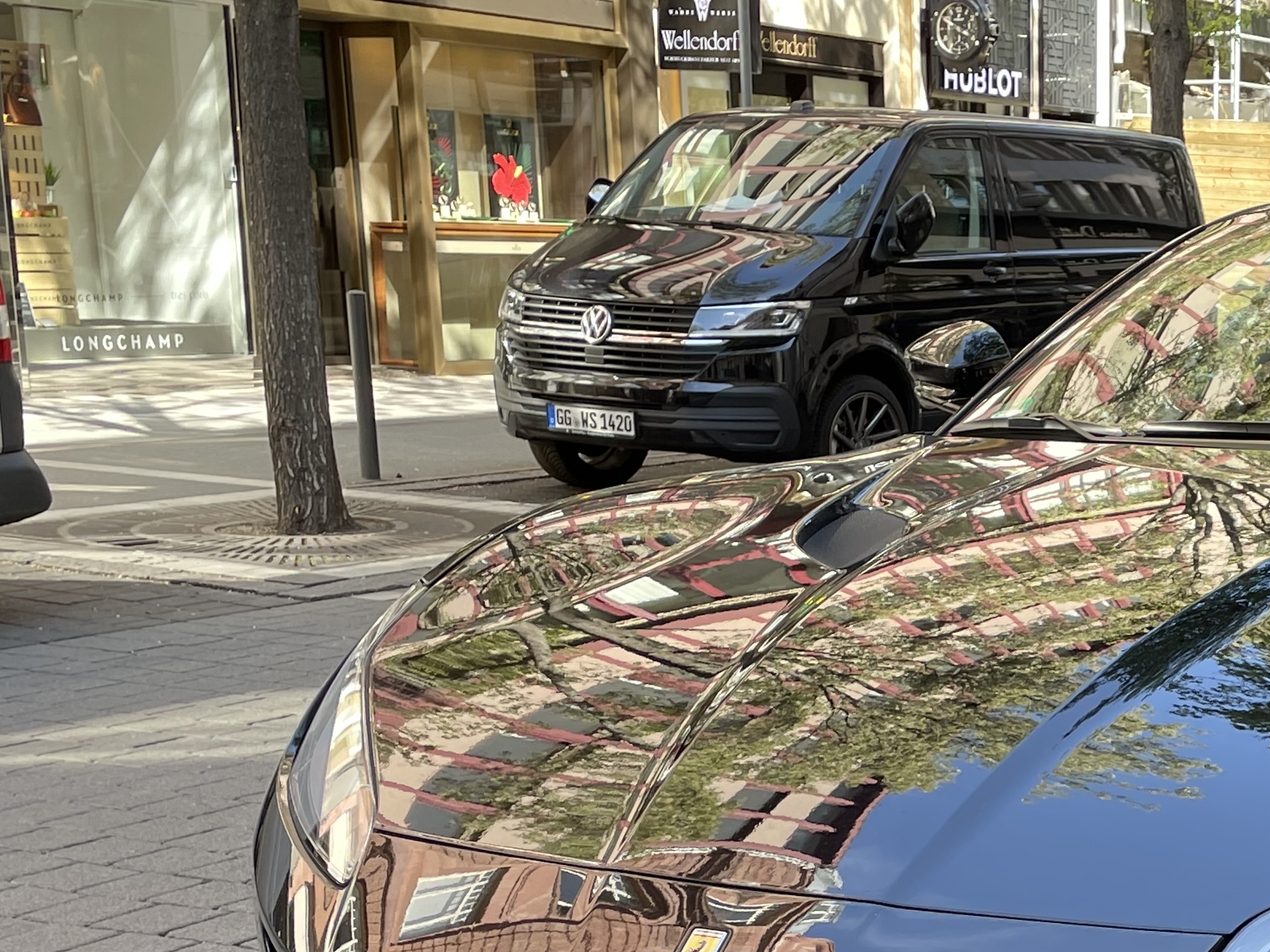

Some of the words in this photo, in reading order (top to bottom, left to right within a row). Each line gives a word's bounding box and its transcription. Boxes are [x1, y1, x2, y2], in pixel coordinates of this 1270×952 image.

[661, 29, 740, 51] Wellendorf
[760, 31, 817, 59] ellendorff
[944, 68, 1022, 97] HUBLOT
[56, 293, 123, 303] LONGCHAMP
[62, 333, 184, 352] LONGCHAMP
[556, 408, 572, 426] GG
[581, 411, 597, 429] WS
[600, 413, 632, 432] 1420
